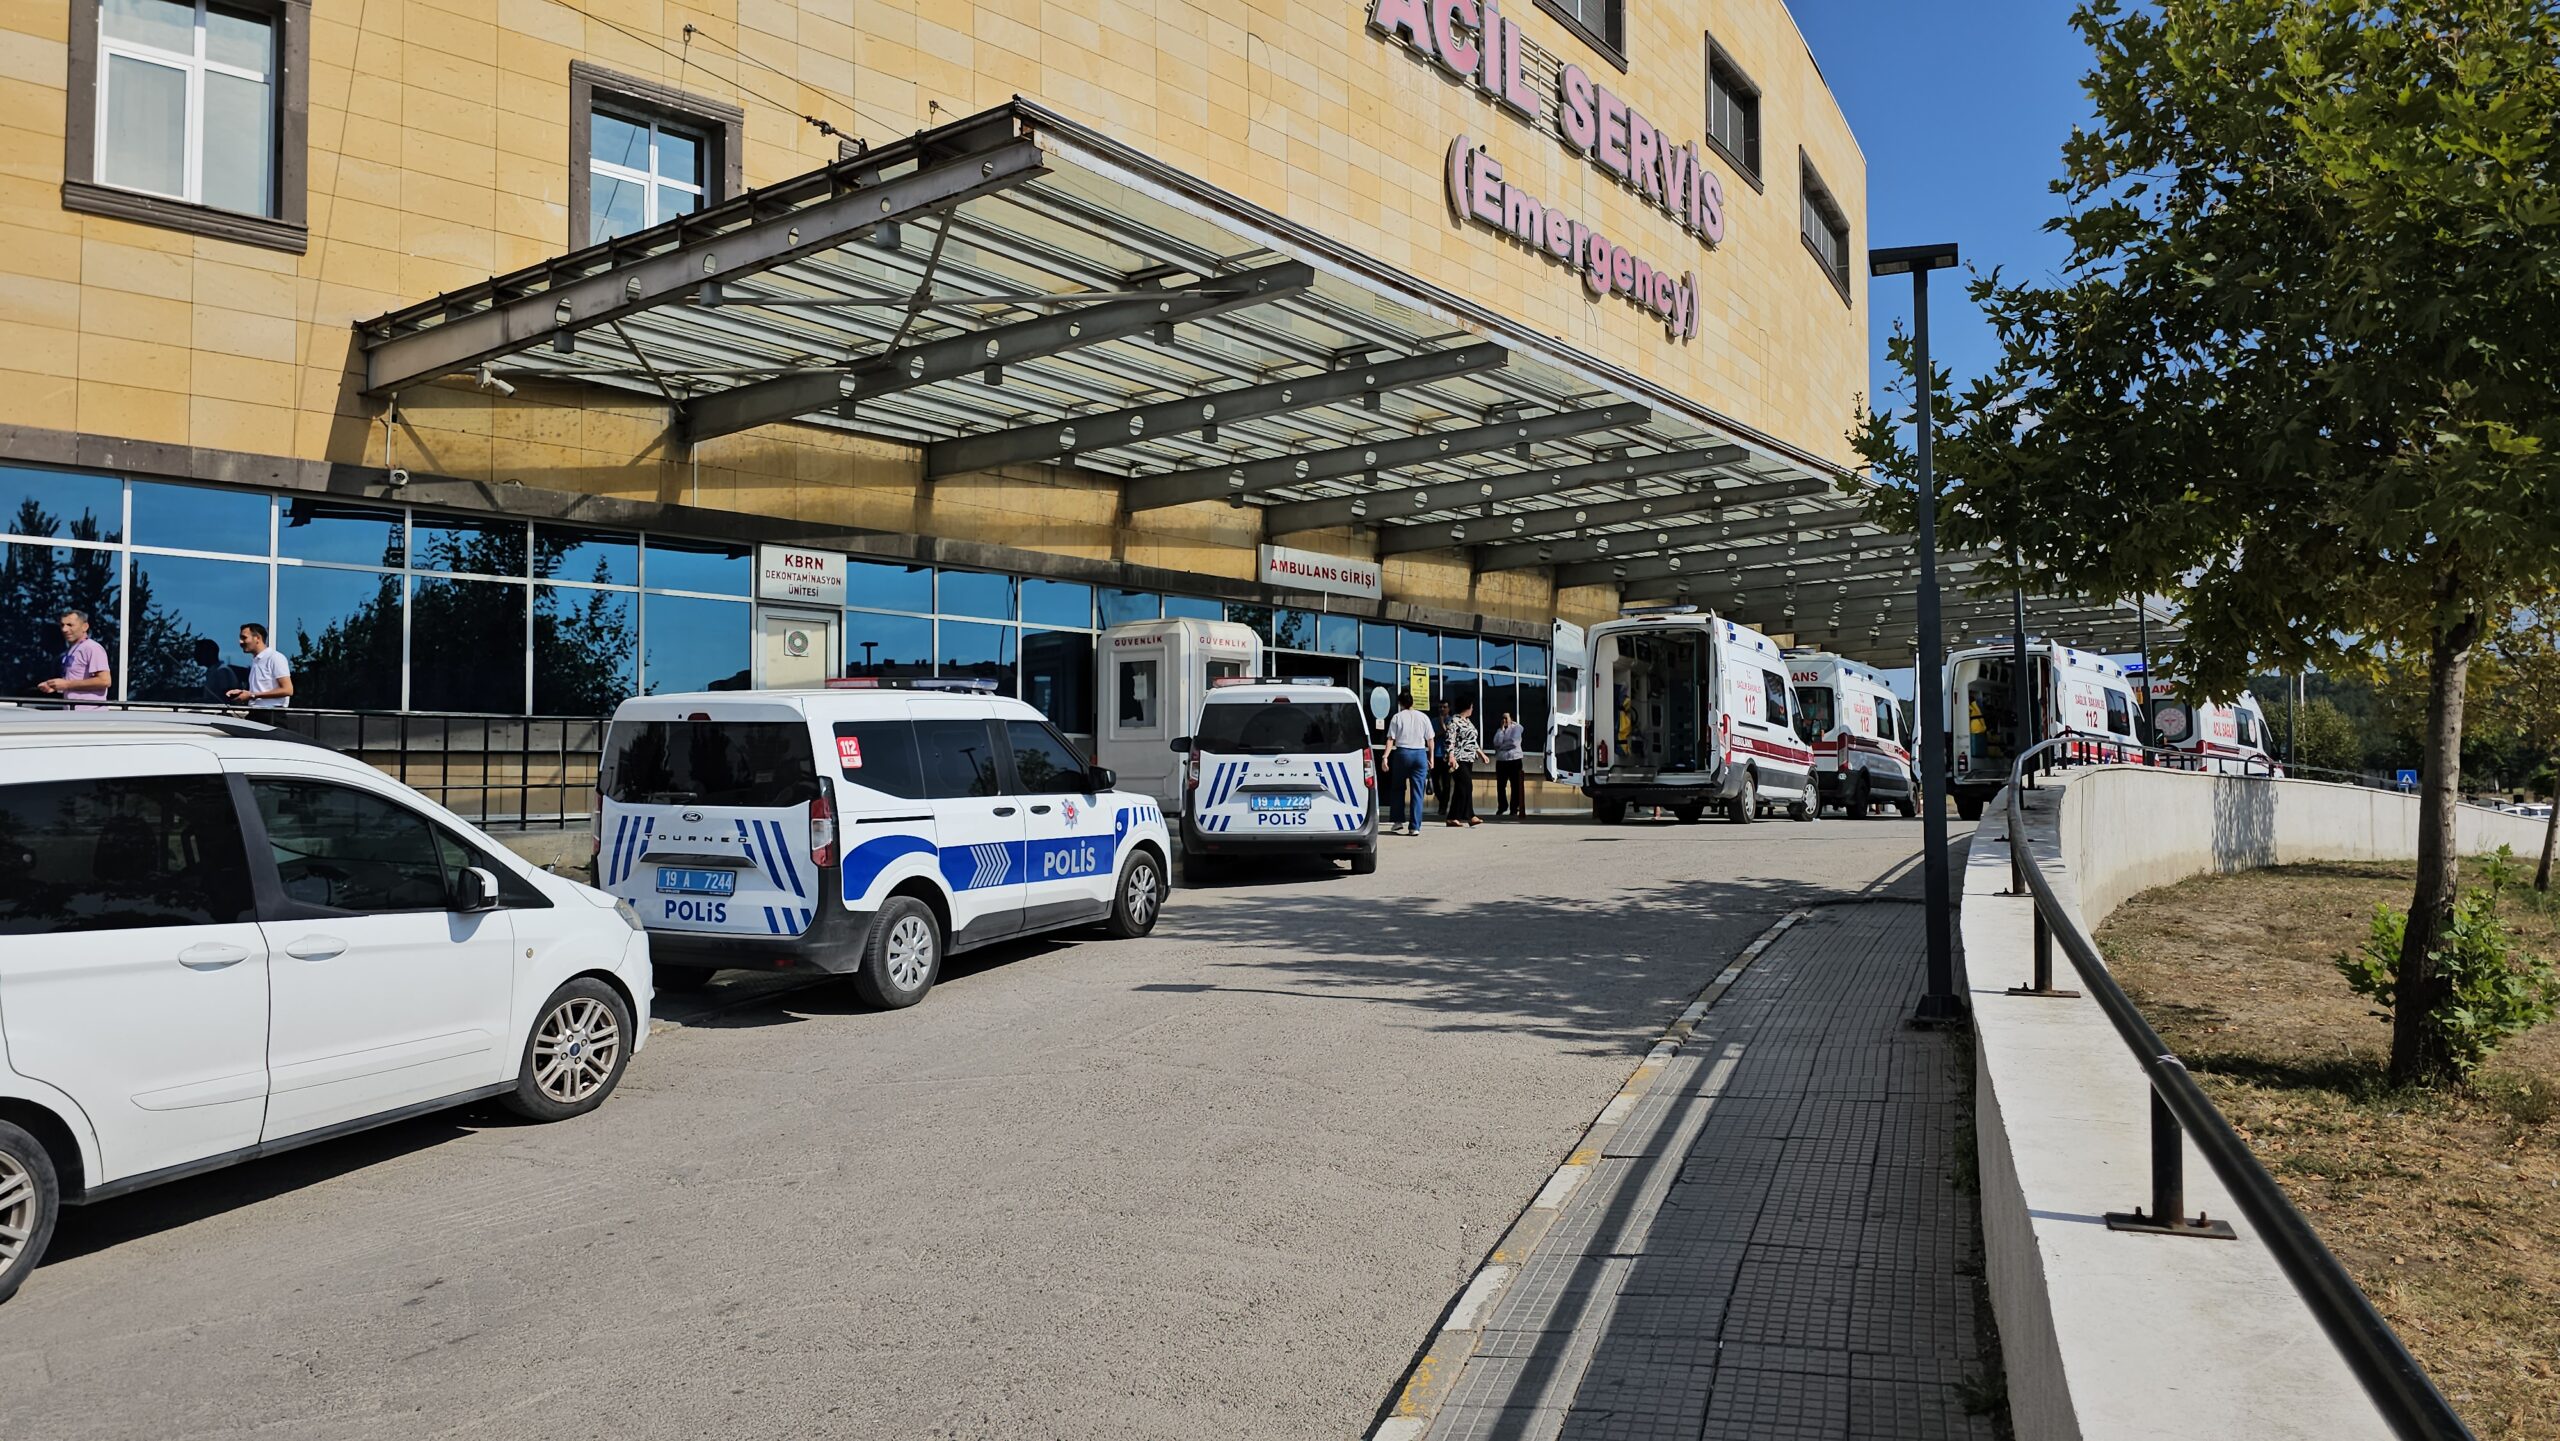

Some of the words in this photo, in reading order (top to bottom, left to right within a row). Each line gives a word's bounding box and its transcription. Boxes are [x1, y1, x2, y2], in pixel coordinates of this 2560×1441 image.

[1559, 63, 1725, 245] SERVİS
[1448, 133, 1700, 339] (Emergency)
[784, 553, 824, 571] KBRN
[765, 569, 841, 586] DEKONTAMİNASYON
[1270, 559, 1337, 581] AMBULANS
[1340, 568, 1376, 589] GİRİŞİ
[788, 584, 819, 597] ÜNİTESİ
[1114, 635, 1163, 647] GÜVENLİK
[1745, 694, 1756, 715] 112
[1860, 715, 1870, 733] 112
[2086, 709, 2098, 728] 112
[840, 740, 859, 756] 112
[1257, 796, 1268, 807] 19
[1273, 796, 1281, 807] A
[645, 833, 748, 843] TOURNEO
[665, 871, 677, 887] 19
[682, 872, 690, 888] A
[704, 873, 732, 890] 7244
